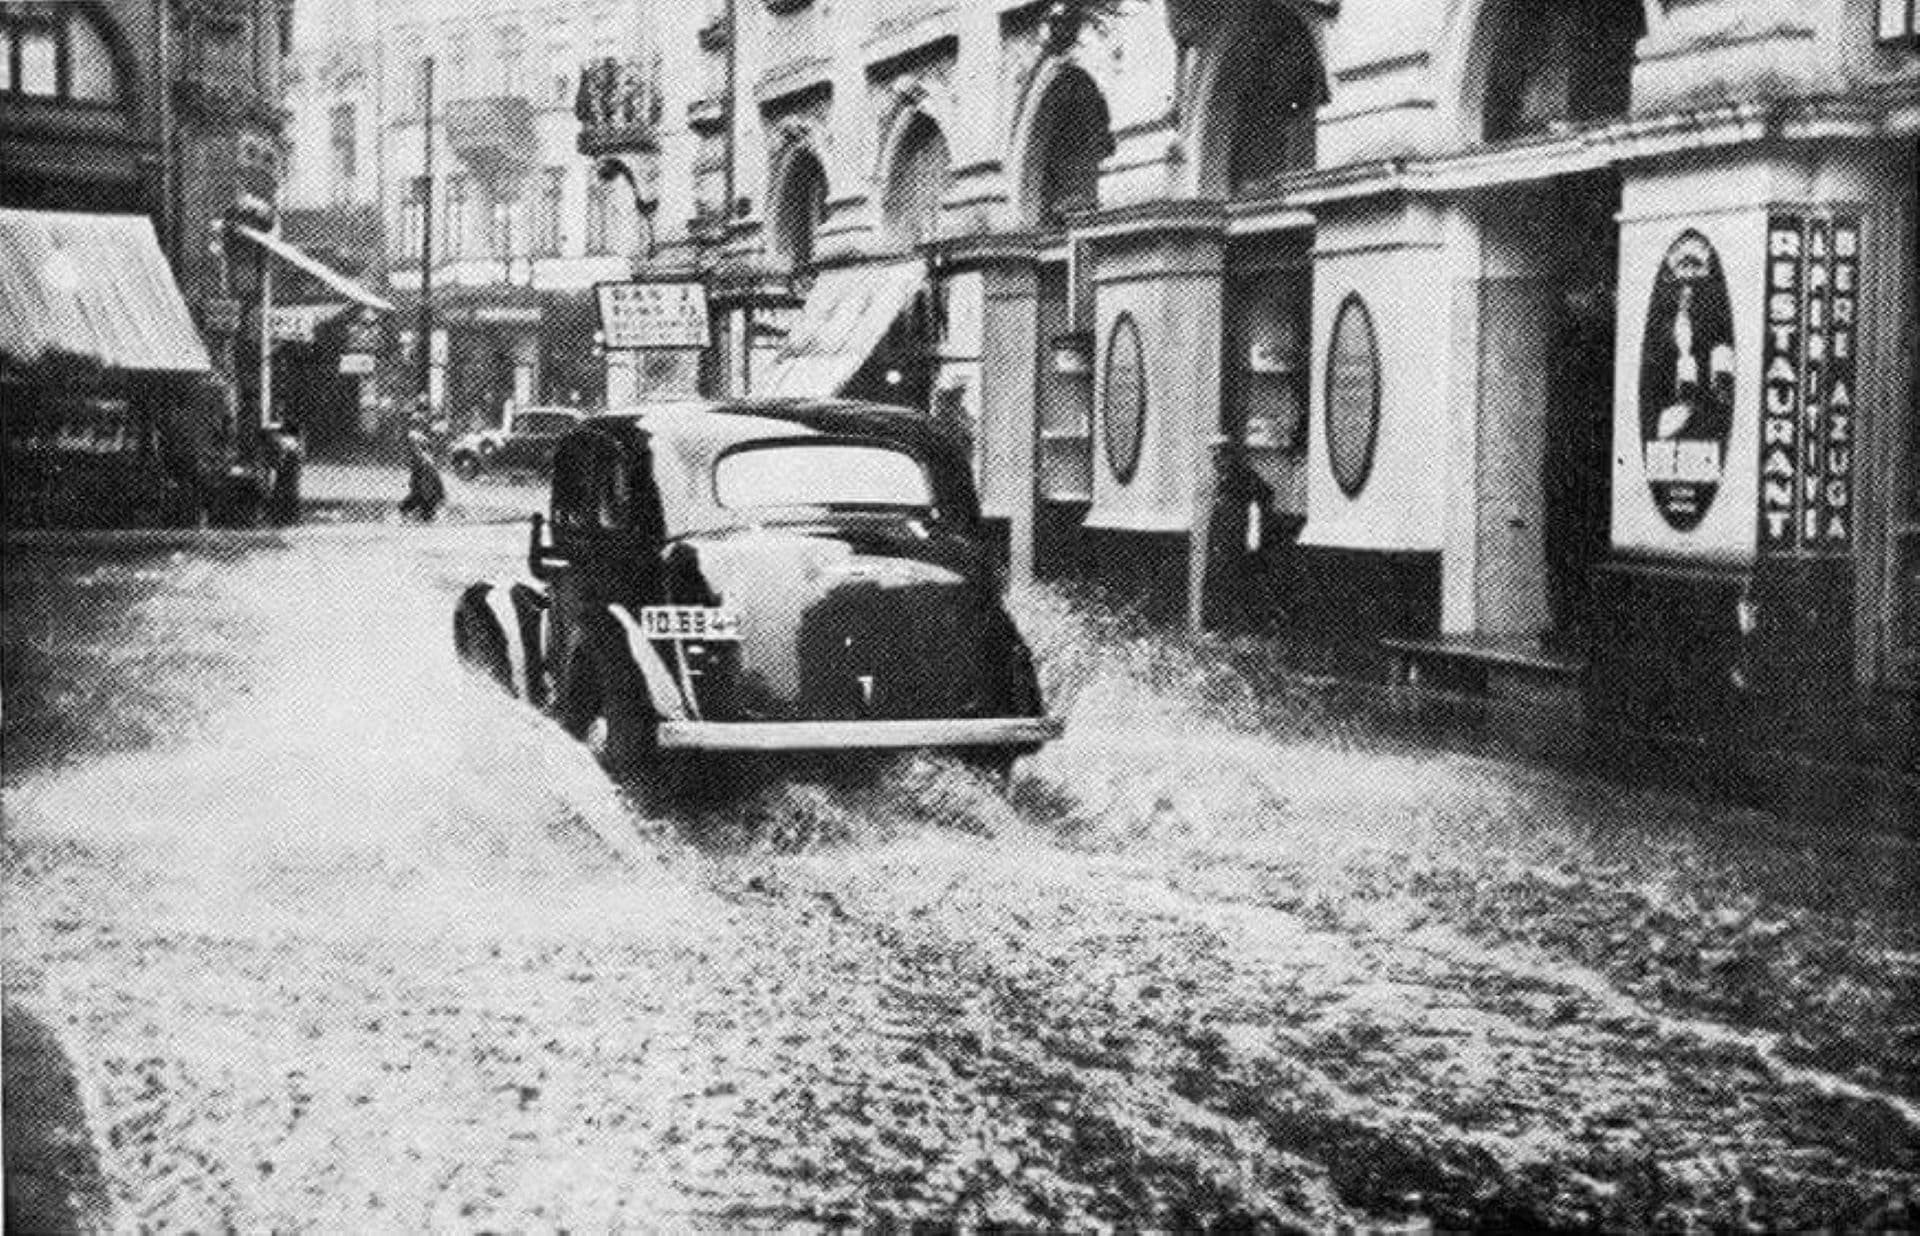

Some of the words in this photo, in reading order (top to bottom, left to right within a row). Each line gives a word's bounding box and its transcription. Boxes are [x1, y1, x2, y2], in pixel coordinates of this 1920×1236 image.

[1833, 230, 1856, 358] BERE
[1765, 230, 1799, 538] RESTAURANT
[1826, 379, 1850, 539] AZUGA
